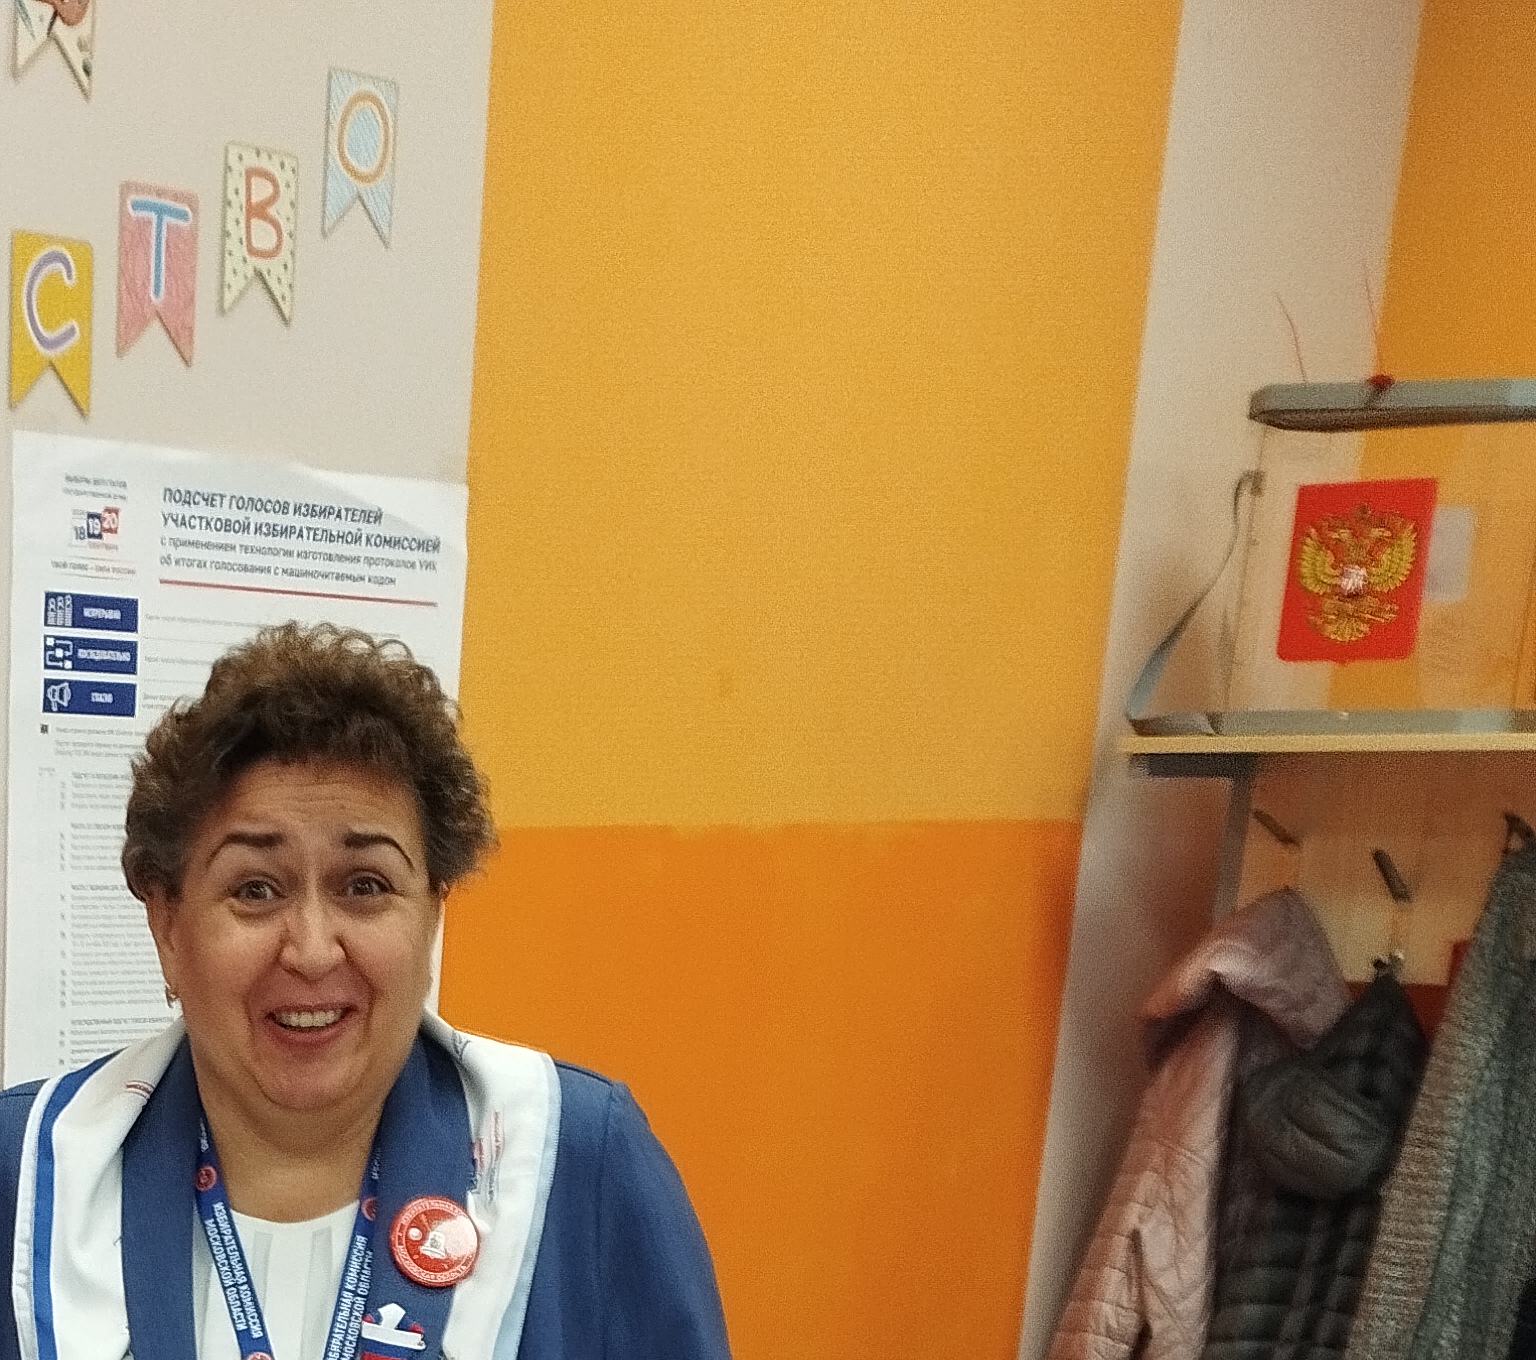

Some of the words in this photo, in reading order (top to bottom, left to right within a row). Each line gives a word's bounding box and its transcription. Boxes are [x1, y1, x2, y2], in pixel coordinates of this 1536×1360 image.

[163, 487, 226, 508] ПОДСЧЕТ
[228, 494, 290, 516] ГОЛОСОВ
[293, 502, 383, 525] ИЗБИРАТЕЛЕЙ
[74, 525, 86, 540] 18
[161, 511, 251, 535] УЧАСТКОВОЙ
[254, 521, 363, 547] ИЗБИРАТЕЛЬНОЙ
[365, 533, 441, 554] КОМИССИЕЙ
[204, 1218, 236, 1288] МОСКОВСКОЙ
[225, 1286, 248, 1331] ОБЛАСТИ
[213, 1201, 247, 1285] ИЗБИРАТЕЛЬНАЯ
[238, 1284, 263, 1339] КОМИССИЯ
[344, 1234, 368, 1291] КОМИССИЯ
